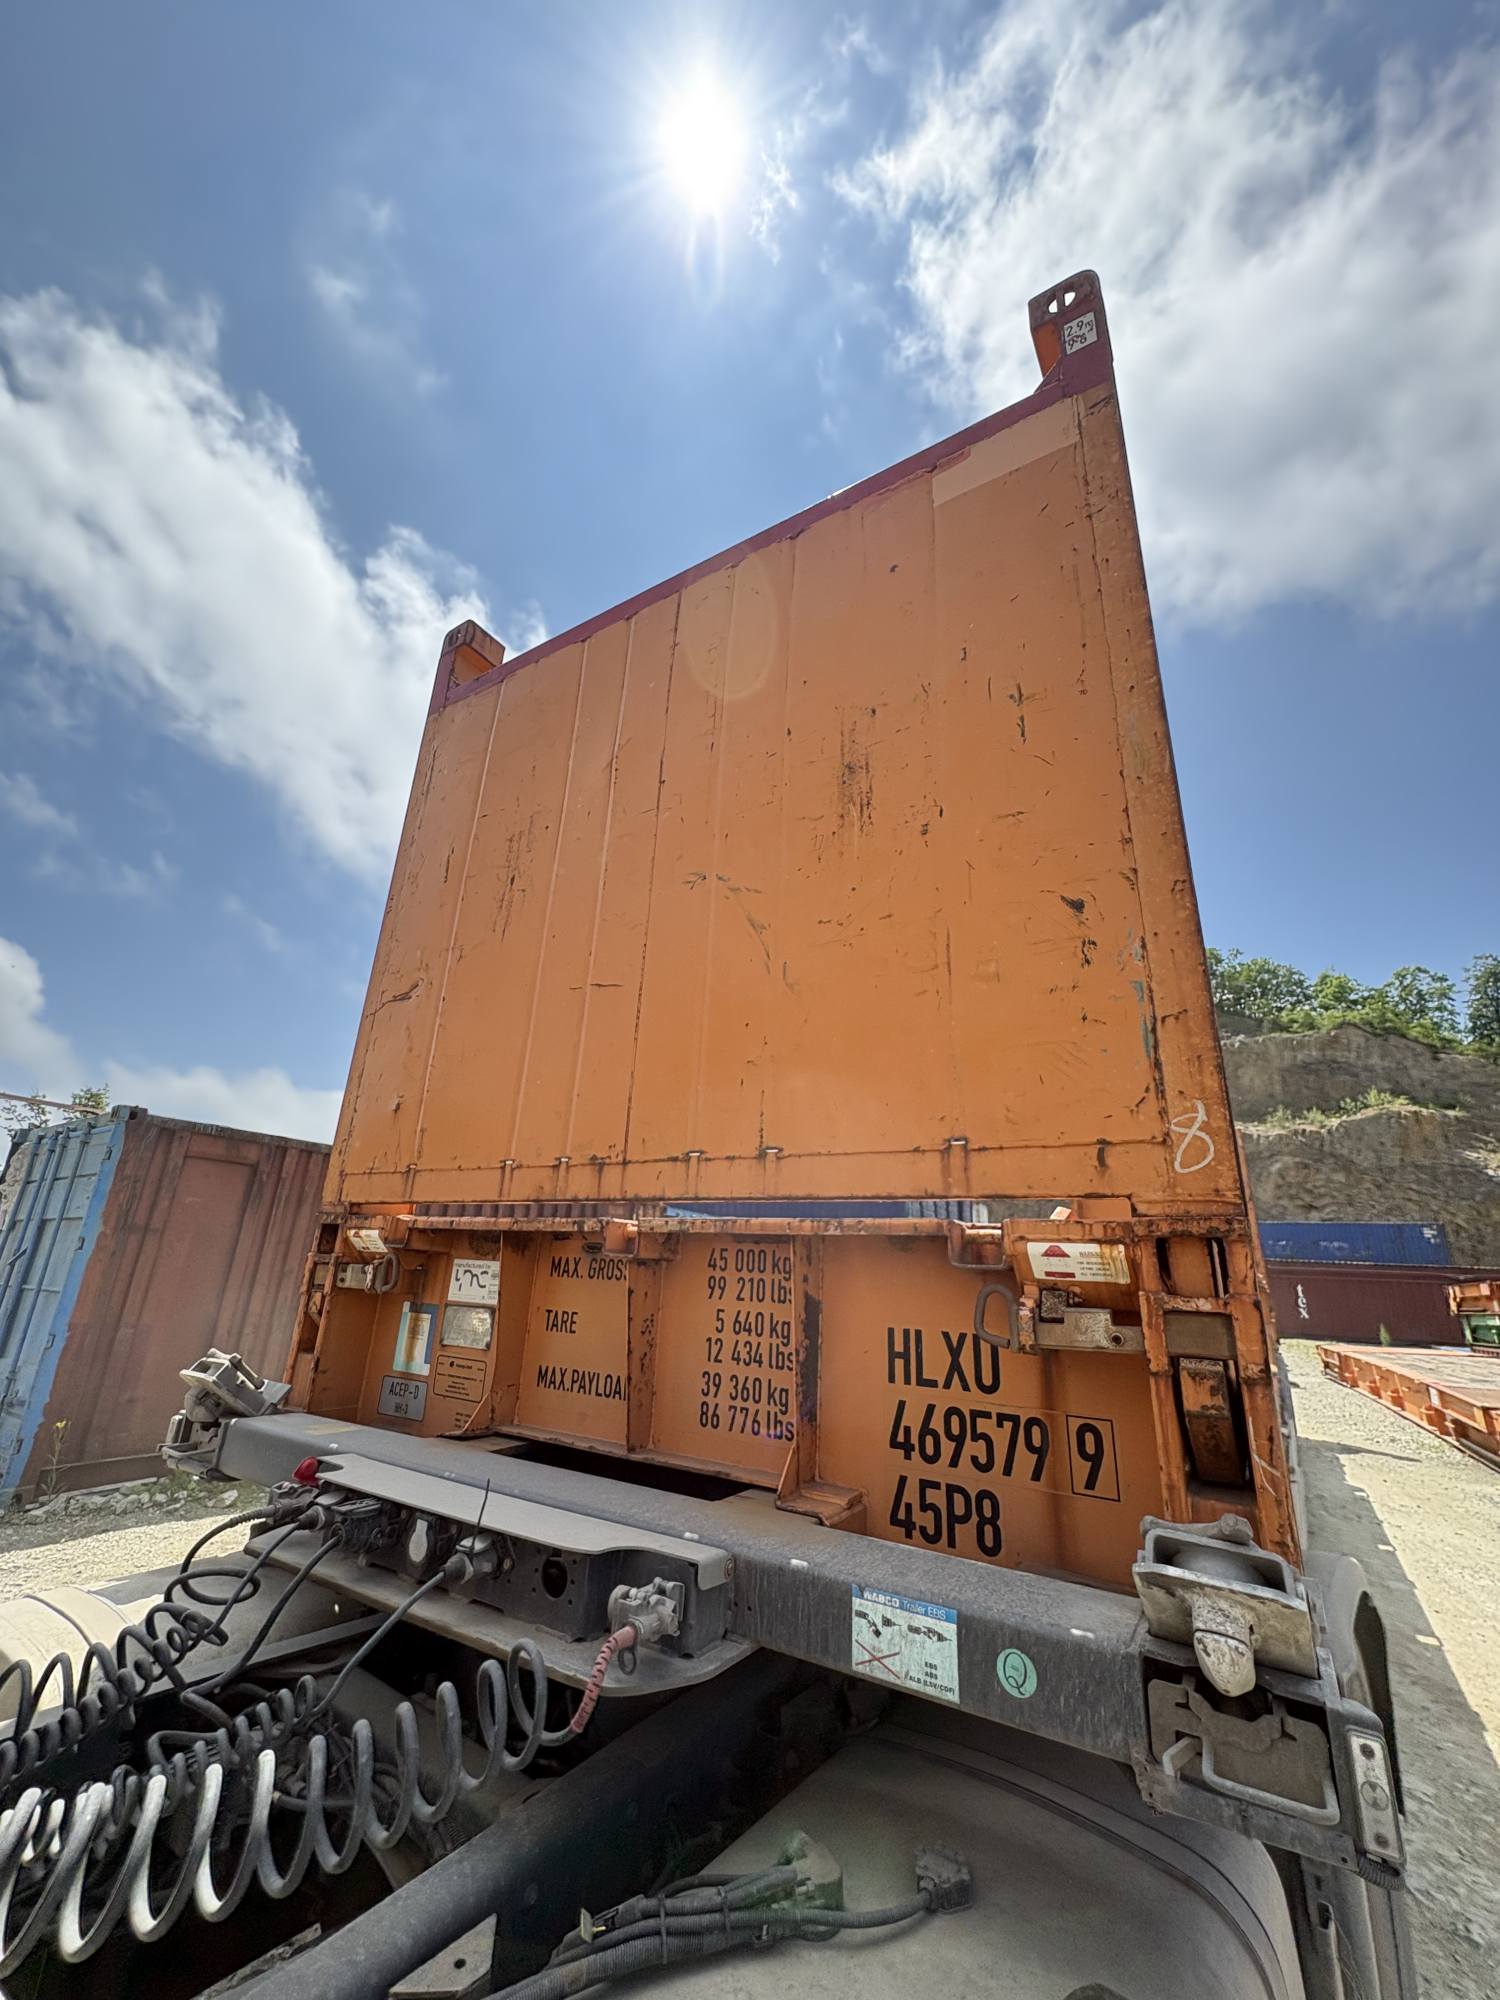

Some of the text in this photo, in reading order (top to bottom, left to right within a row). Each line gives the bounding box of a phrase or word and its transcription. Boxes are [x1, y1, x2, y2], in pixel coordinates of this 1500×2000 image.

[1170, 1099, 1214, 1173] 8
[550, 1256, 583, 1278] MAX.
[708, 1248, 791, 1281] 45 000 kg
[708, 1275, 726, 1299] 99
[736, 1277, 766, 1302] 210
[545, 1309, 578, 1334] TARE
[715, 1309, 791, 1347] 5 640 kg
[706, 1337, 794, 1371] 12 434 lbs
[886, 1327, 1001, 1394] HLXU
[536, 1364, 627, 1401] MAX.PAYLOA
[701, 1371, 789, 1415] 39 360 kg
[700, 1401, 794, 1442] 86 776 lbs
[889, 1400, 1105, 1491] 469579 9
[889, 1475, 1002, 1557] 45P8
[863, 1590, 946, 1620] WABCO Trailer EBS
